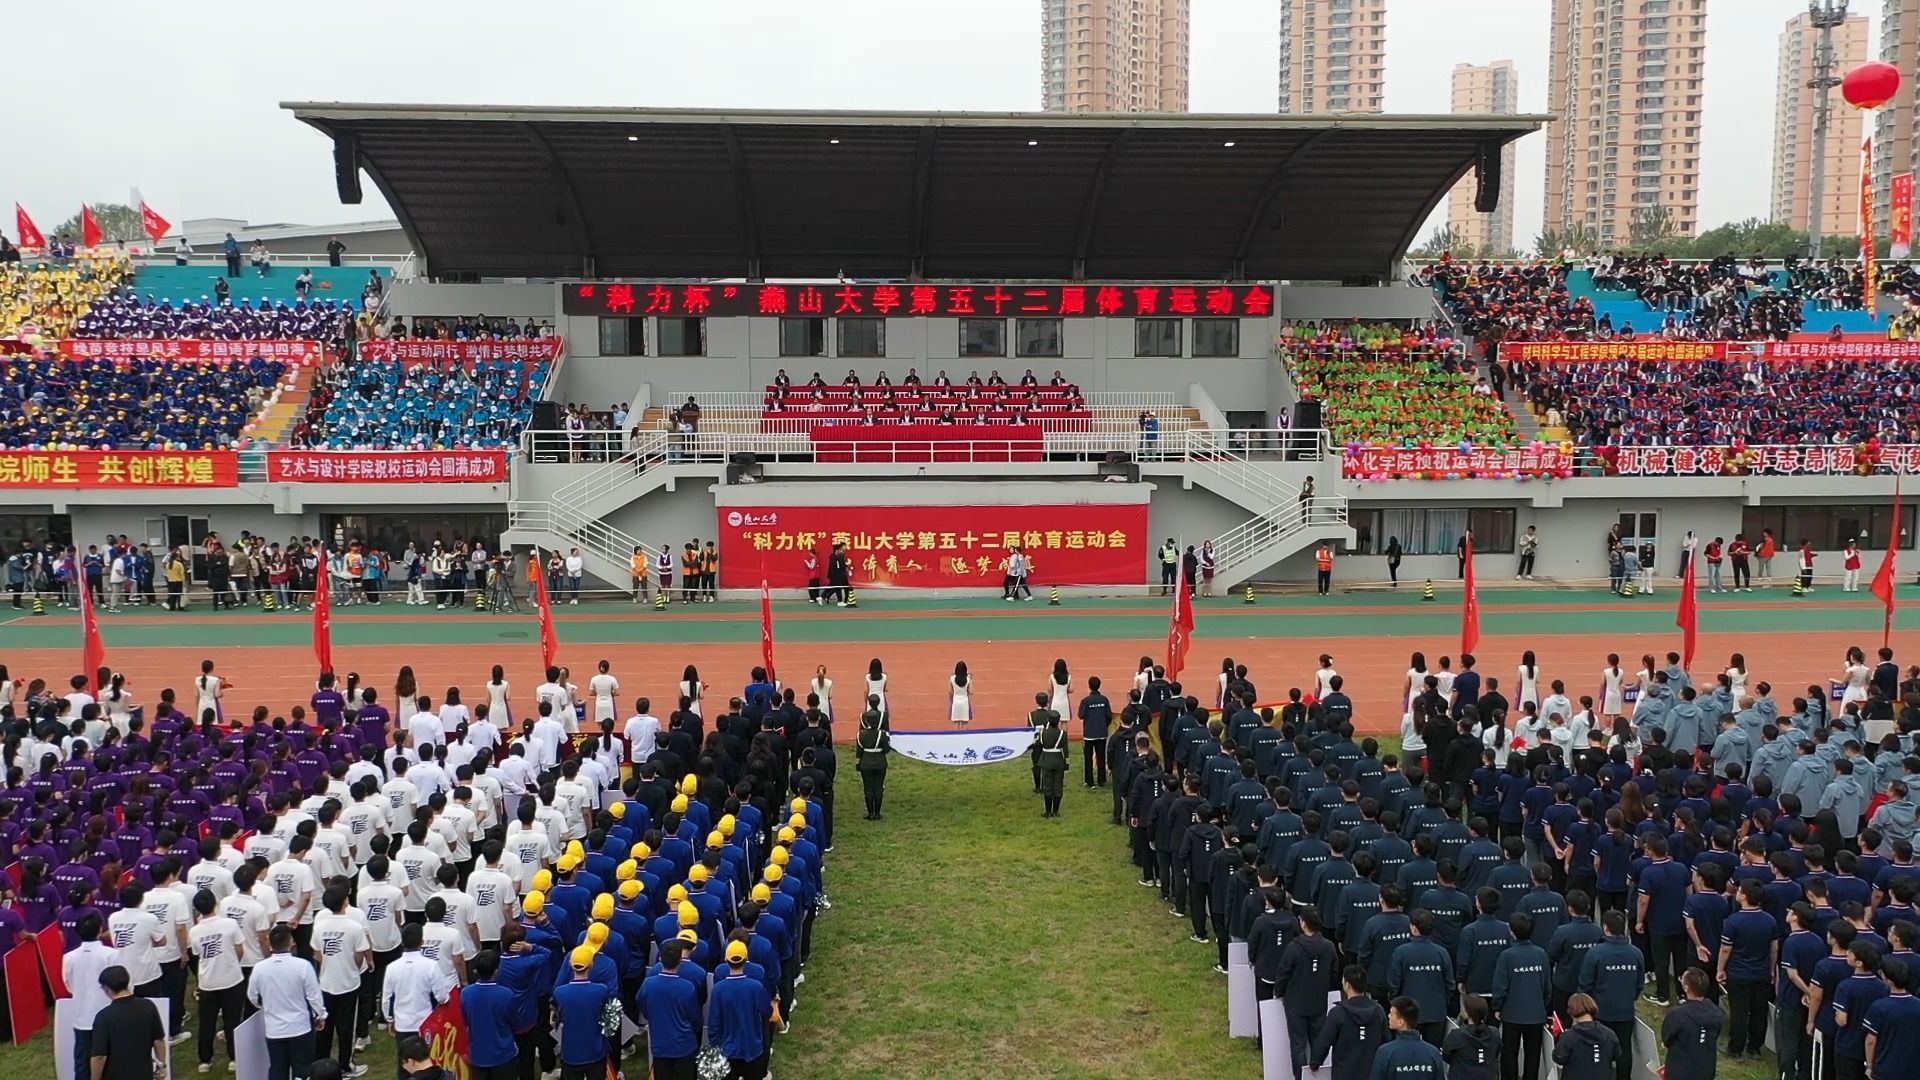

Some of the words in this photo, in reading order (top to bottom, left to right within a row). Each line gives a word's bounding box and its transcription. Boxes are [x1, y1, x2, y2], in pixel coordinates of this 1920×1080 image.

[1772, 343, 1920, 357] 建筑工程与力学学院预祝本届运动会
[98, 456, 215, 484] 共创辉煌
[279, 456, 496, 479] 艺术与设计学院祝校运动会圆满成功
[1617, 449, 1723, 473] 机械健将
[1750, 448, 1855, 472] 斗志昂扬
[742, 530, 1127, 551] “科力杯”燕山大学第五十二届体育运动会
